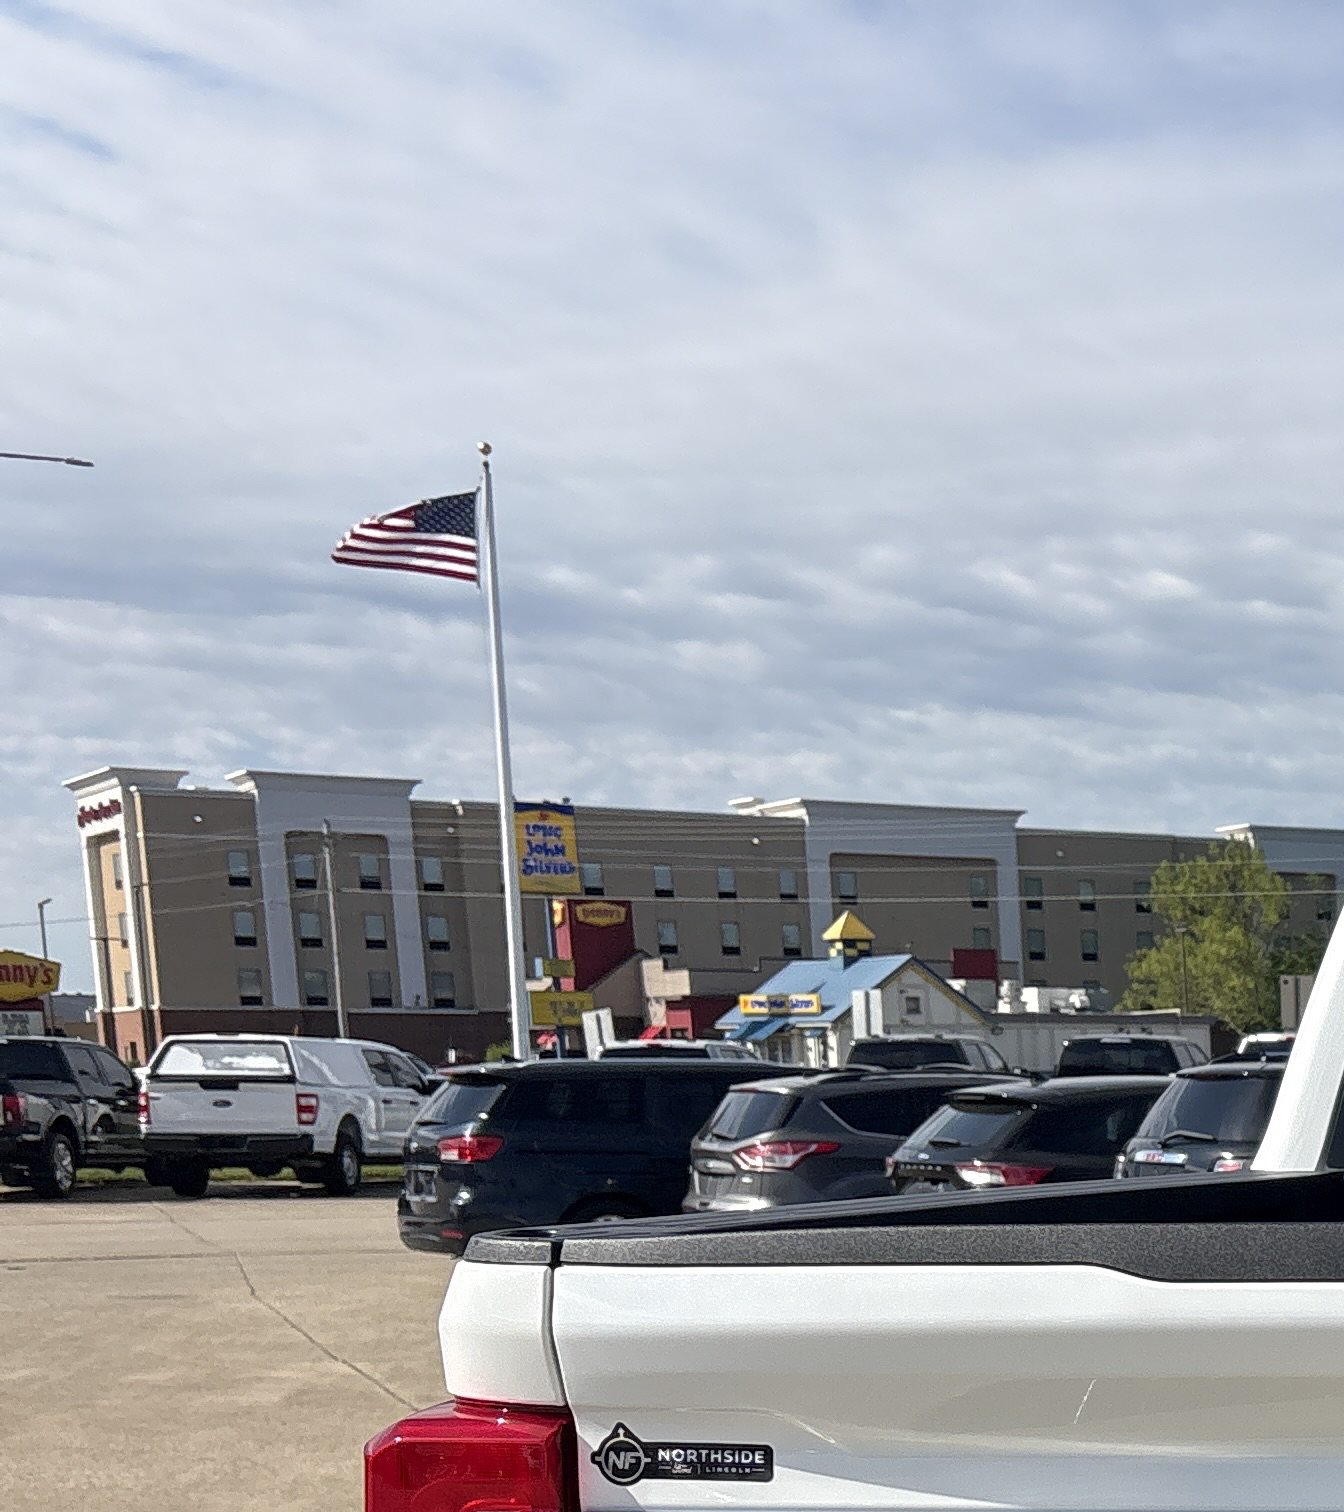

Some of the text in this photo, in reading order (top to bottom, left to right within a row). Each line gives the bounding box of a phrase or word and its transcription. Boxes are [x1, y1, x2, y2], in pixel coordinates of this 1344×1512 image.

[608, 1451, 642, 1474] NF
[657, 1448, 766, 1464] NORTHSIDE
[705, 1466, 751, 1474] LINCOLN
